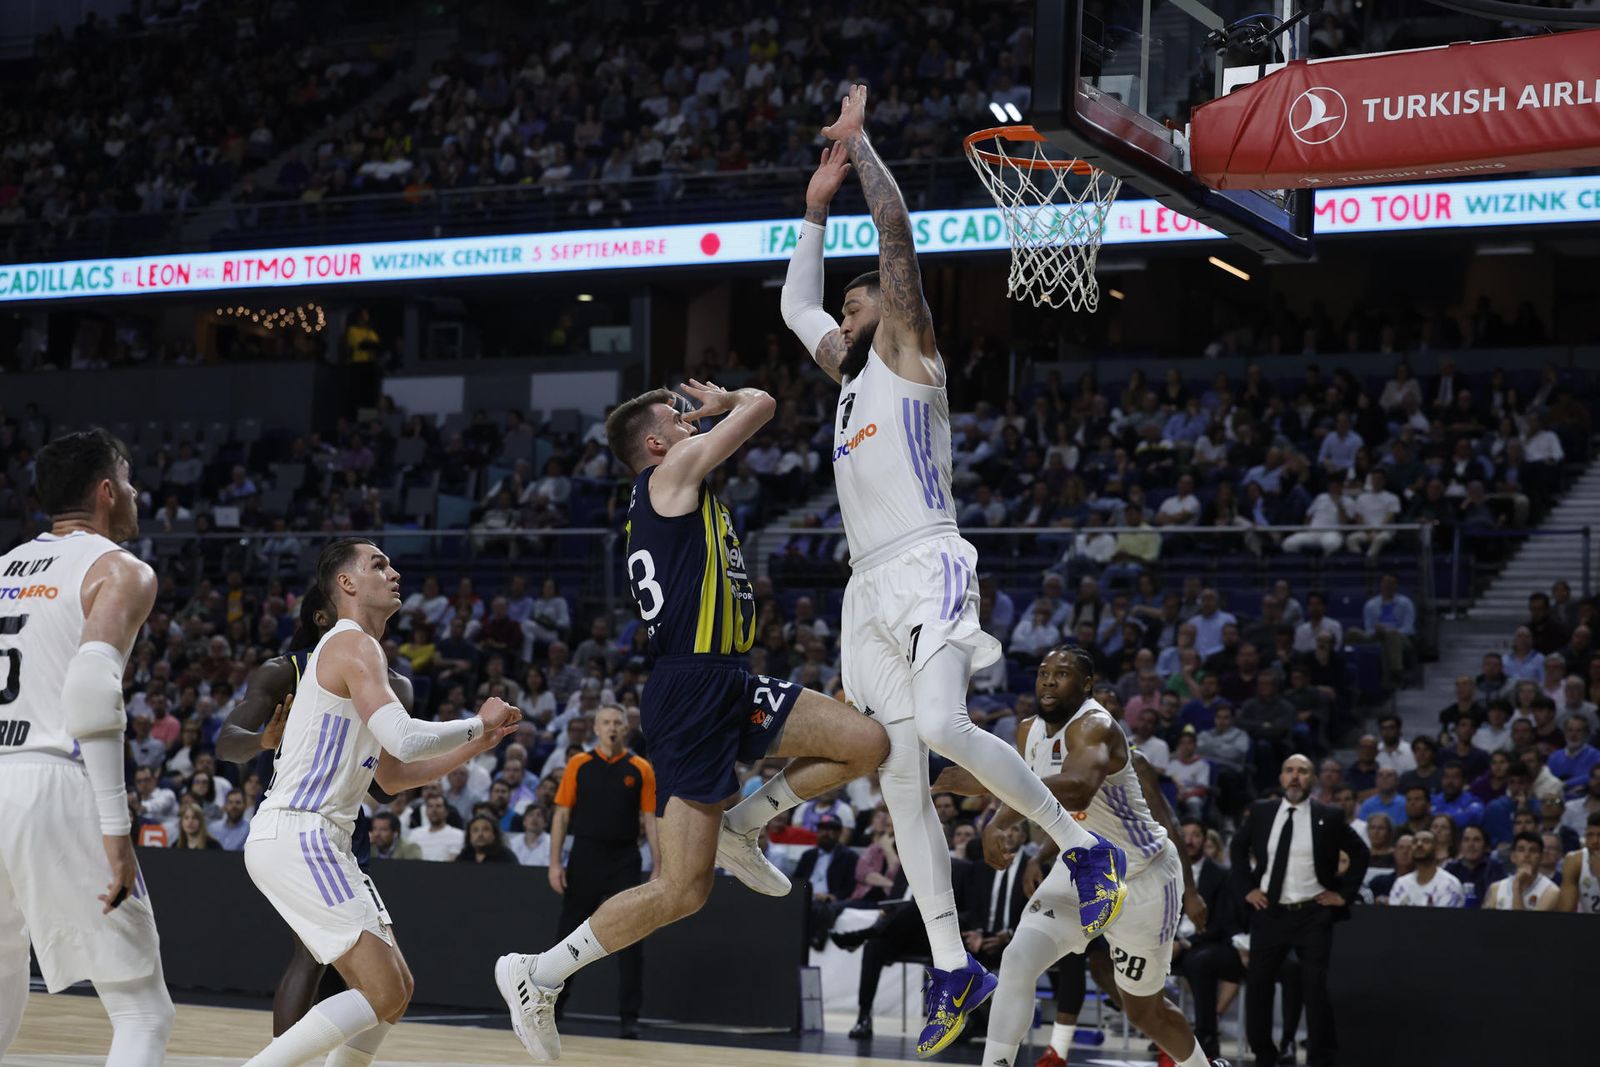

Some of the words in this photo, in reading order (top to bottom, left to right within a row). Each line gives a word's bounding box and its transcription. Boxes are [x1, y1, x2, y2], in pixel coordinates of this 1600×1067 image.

[1362, 87, 1506, 123] TURKISH
[1516, 79, 1600, 110] AIRLI
[1338, 171, 1418, 183] TURKISH
[1424, 162, 1507, 176] AIRLINES
[1140, 208, 1213, 234] LEO
[1371, 193, 1452, 223] TOUR
[1465, 190, 1567, 215] WIZINK
[0, 266, 114, 295] CADILLACS
[137, 263, 190, 288] LEON
[222, 257, 296, 283] RITMO
[304, 253, 362, 279] TOUR
[372, 250, 445, 271] WIZINK
[453, 246, 523, 267] CENTER
[532, 245, 542, 262] 5
[550, 238, 668, 260] SEPTIEMBRE
[3, 555, 60, 578] RUDY
[1112, 946, 1147, 982] 28
